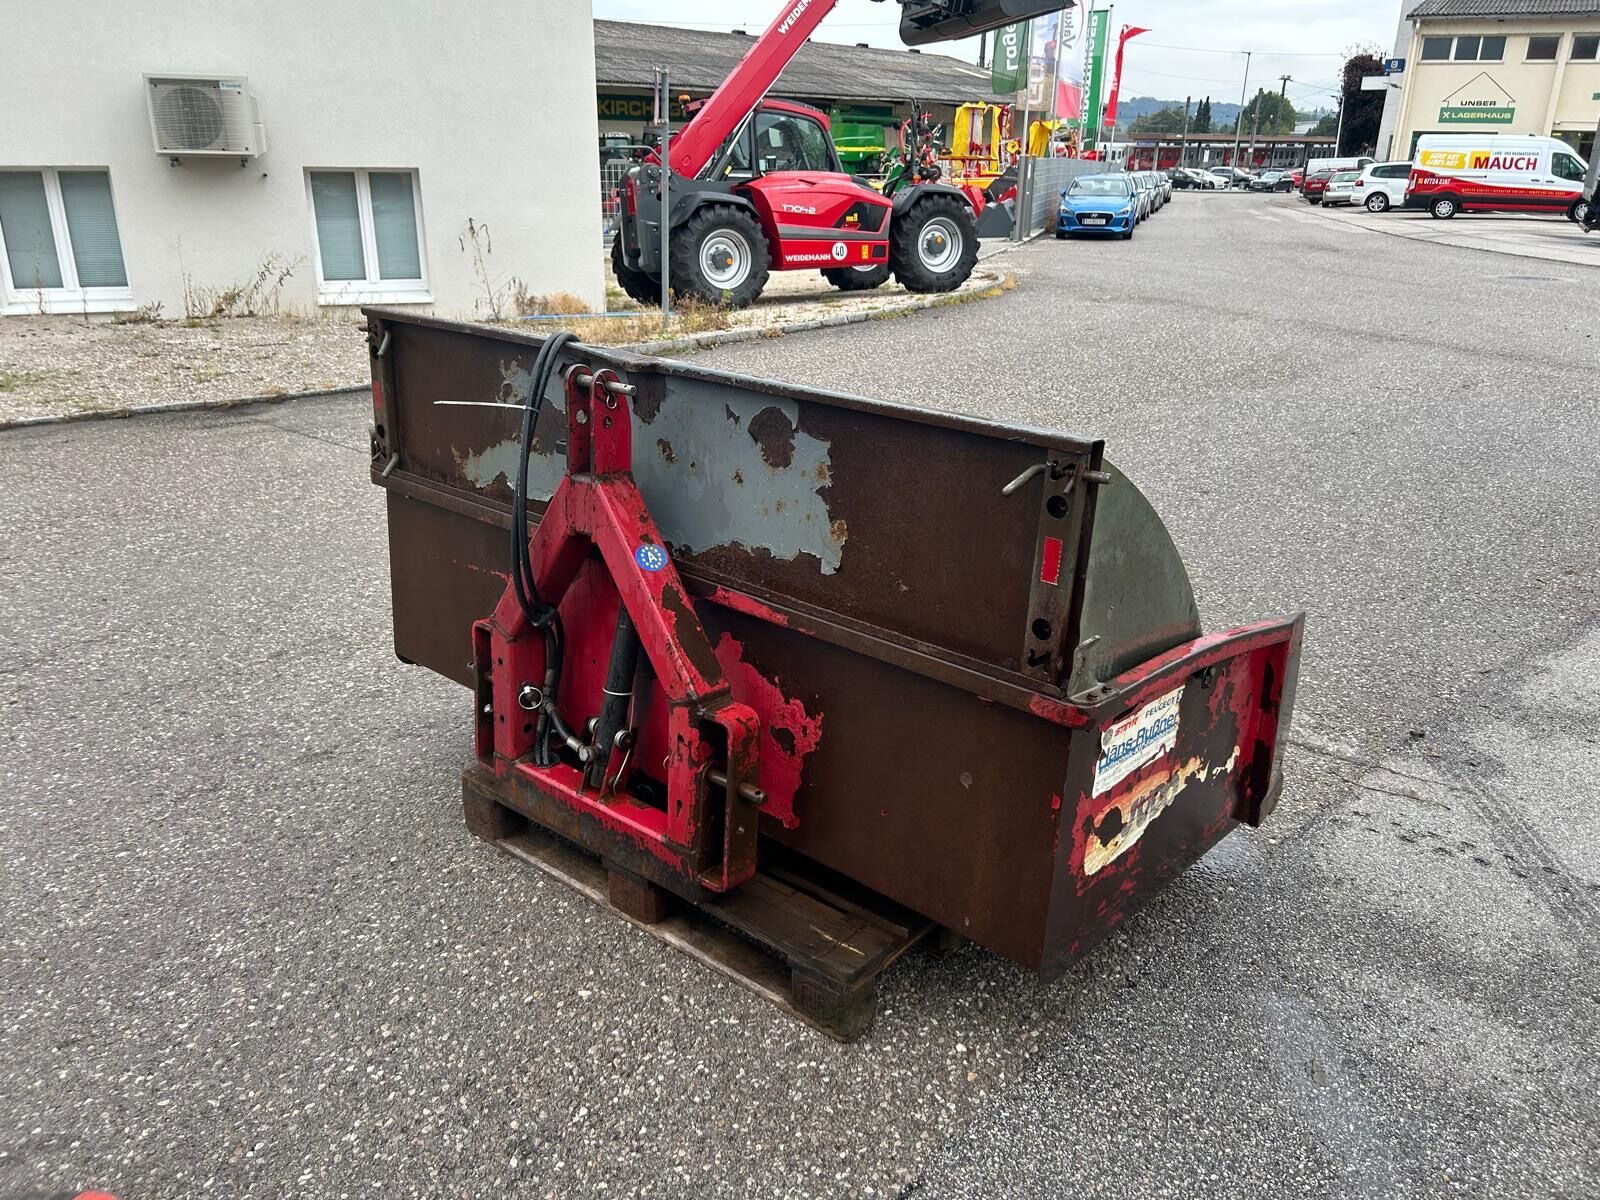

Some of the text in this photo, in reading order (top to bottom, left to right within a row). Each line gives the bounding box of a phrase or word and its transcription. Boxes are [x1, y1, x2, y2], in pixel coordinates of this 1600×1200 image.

[1451, 111, 1511, 119] LAGERHAUS
[1473, 156, 1538, 170] MAUCH
[781, 203, 816, 215] T7042
[835, 245, 844, 257] 40
[785, 253, 831, 262] WEIDEMANN
[647, 551, 658, 564] A
